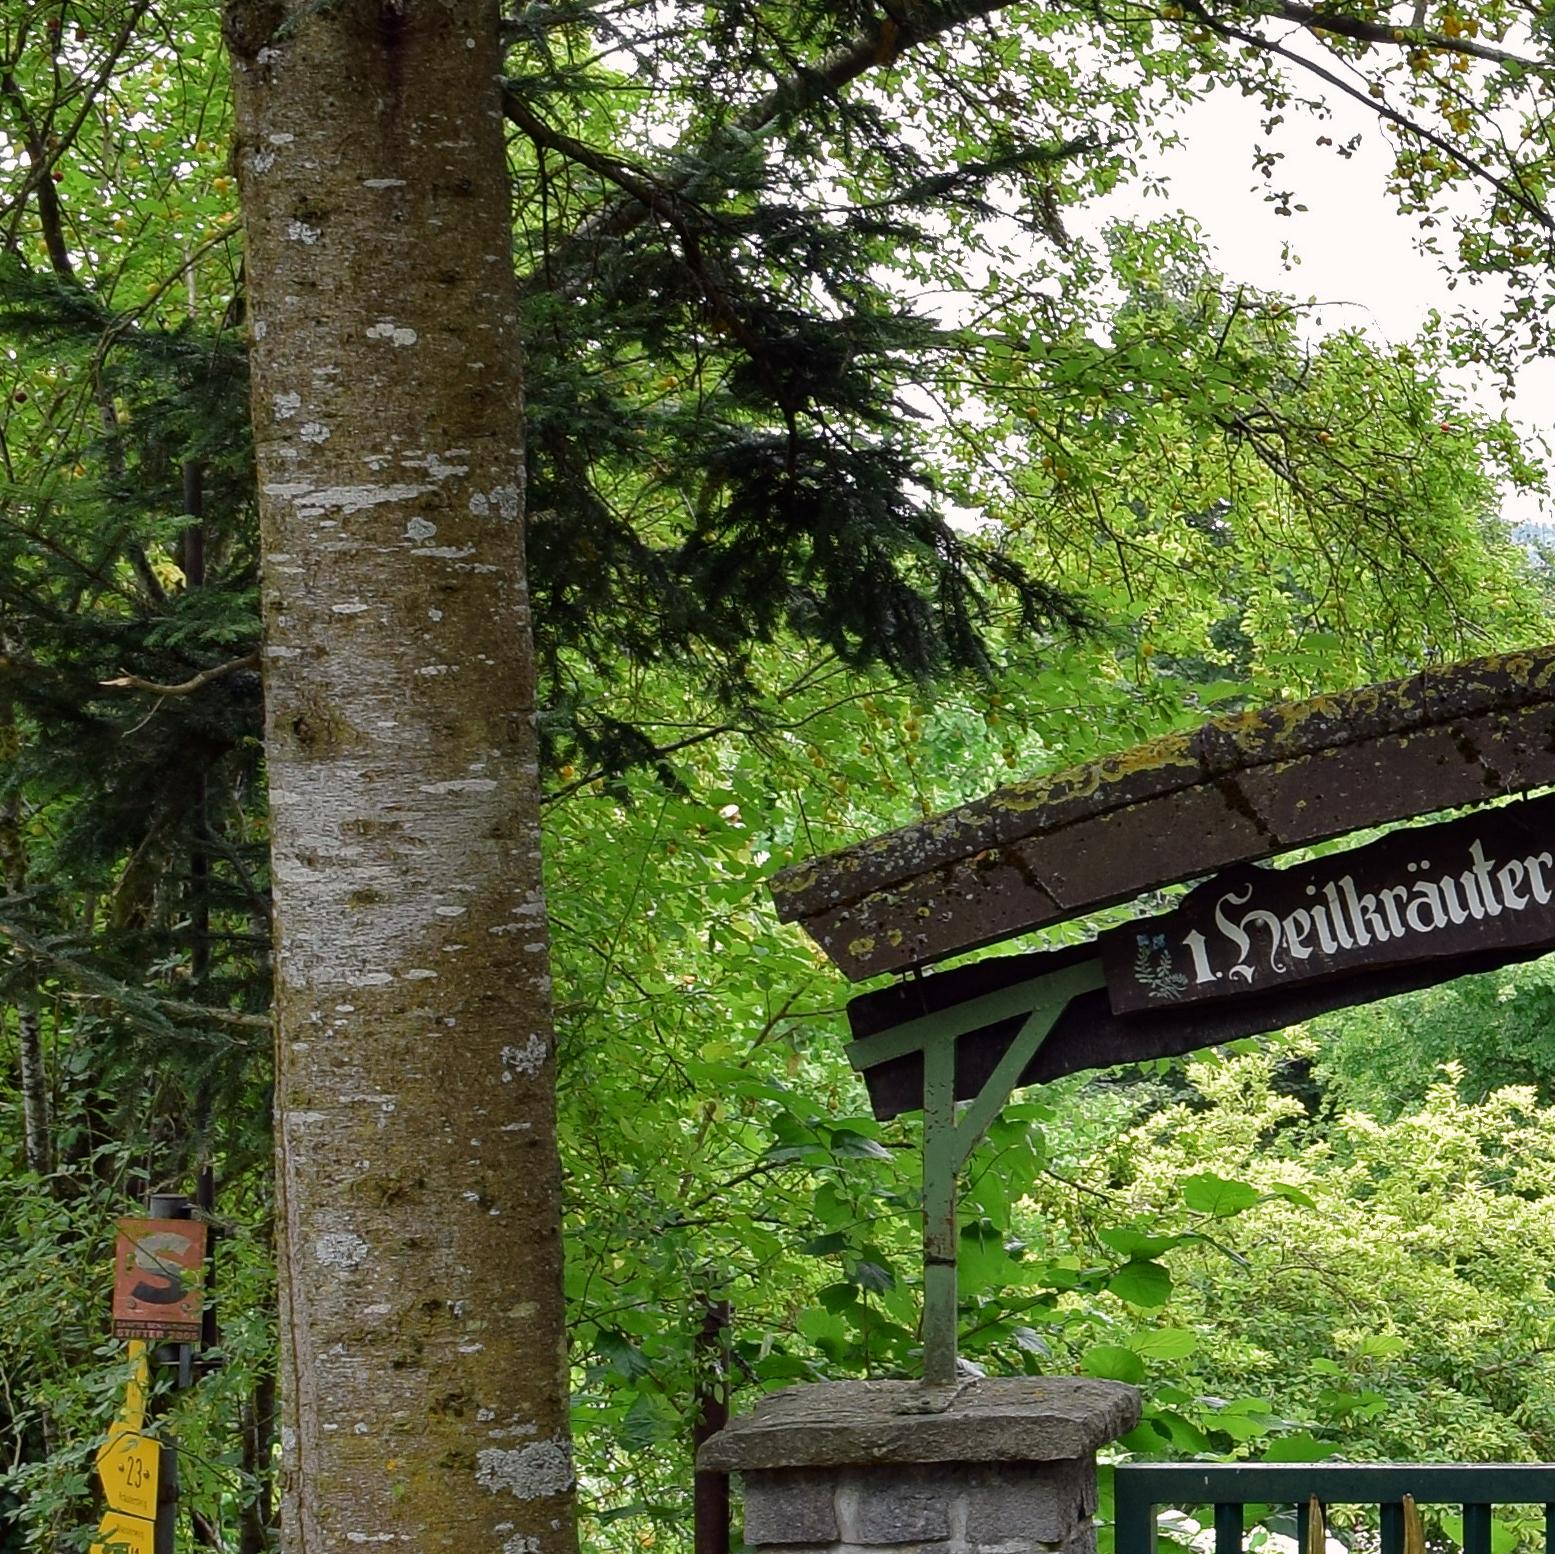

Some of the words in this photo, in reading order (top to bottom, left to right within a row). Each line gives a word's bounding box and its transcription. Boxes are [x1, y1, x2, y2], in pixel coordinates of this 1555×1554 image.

[1182, 929, 1223, 983] 1.
[1215, 839, 1552, 983] Heilkräuter
[127, 1455, 143, 1489] 23
